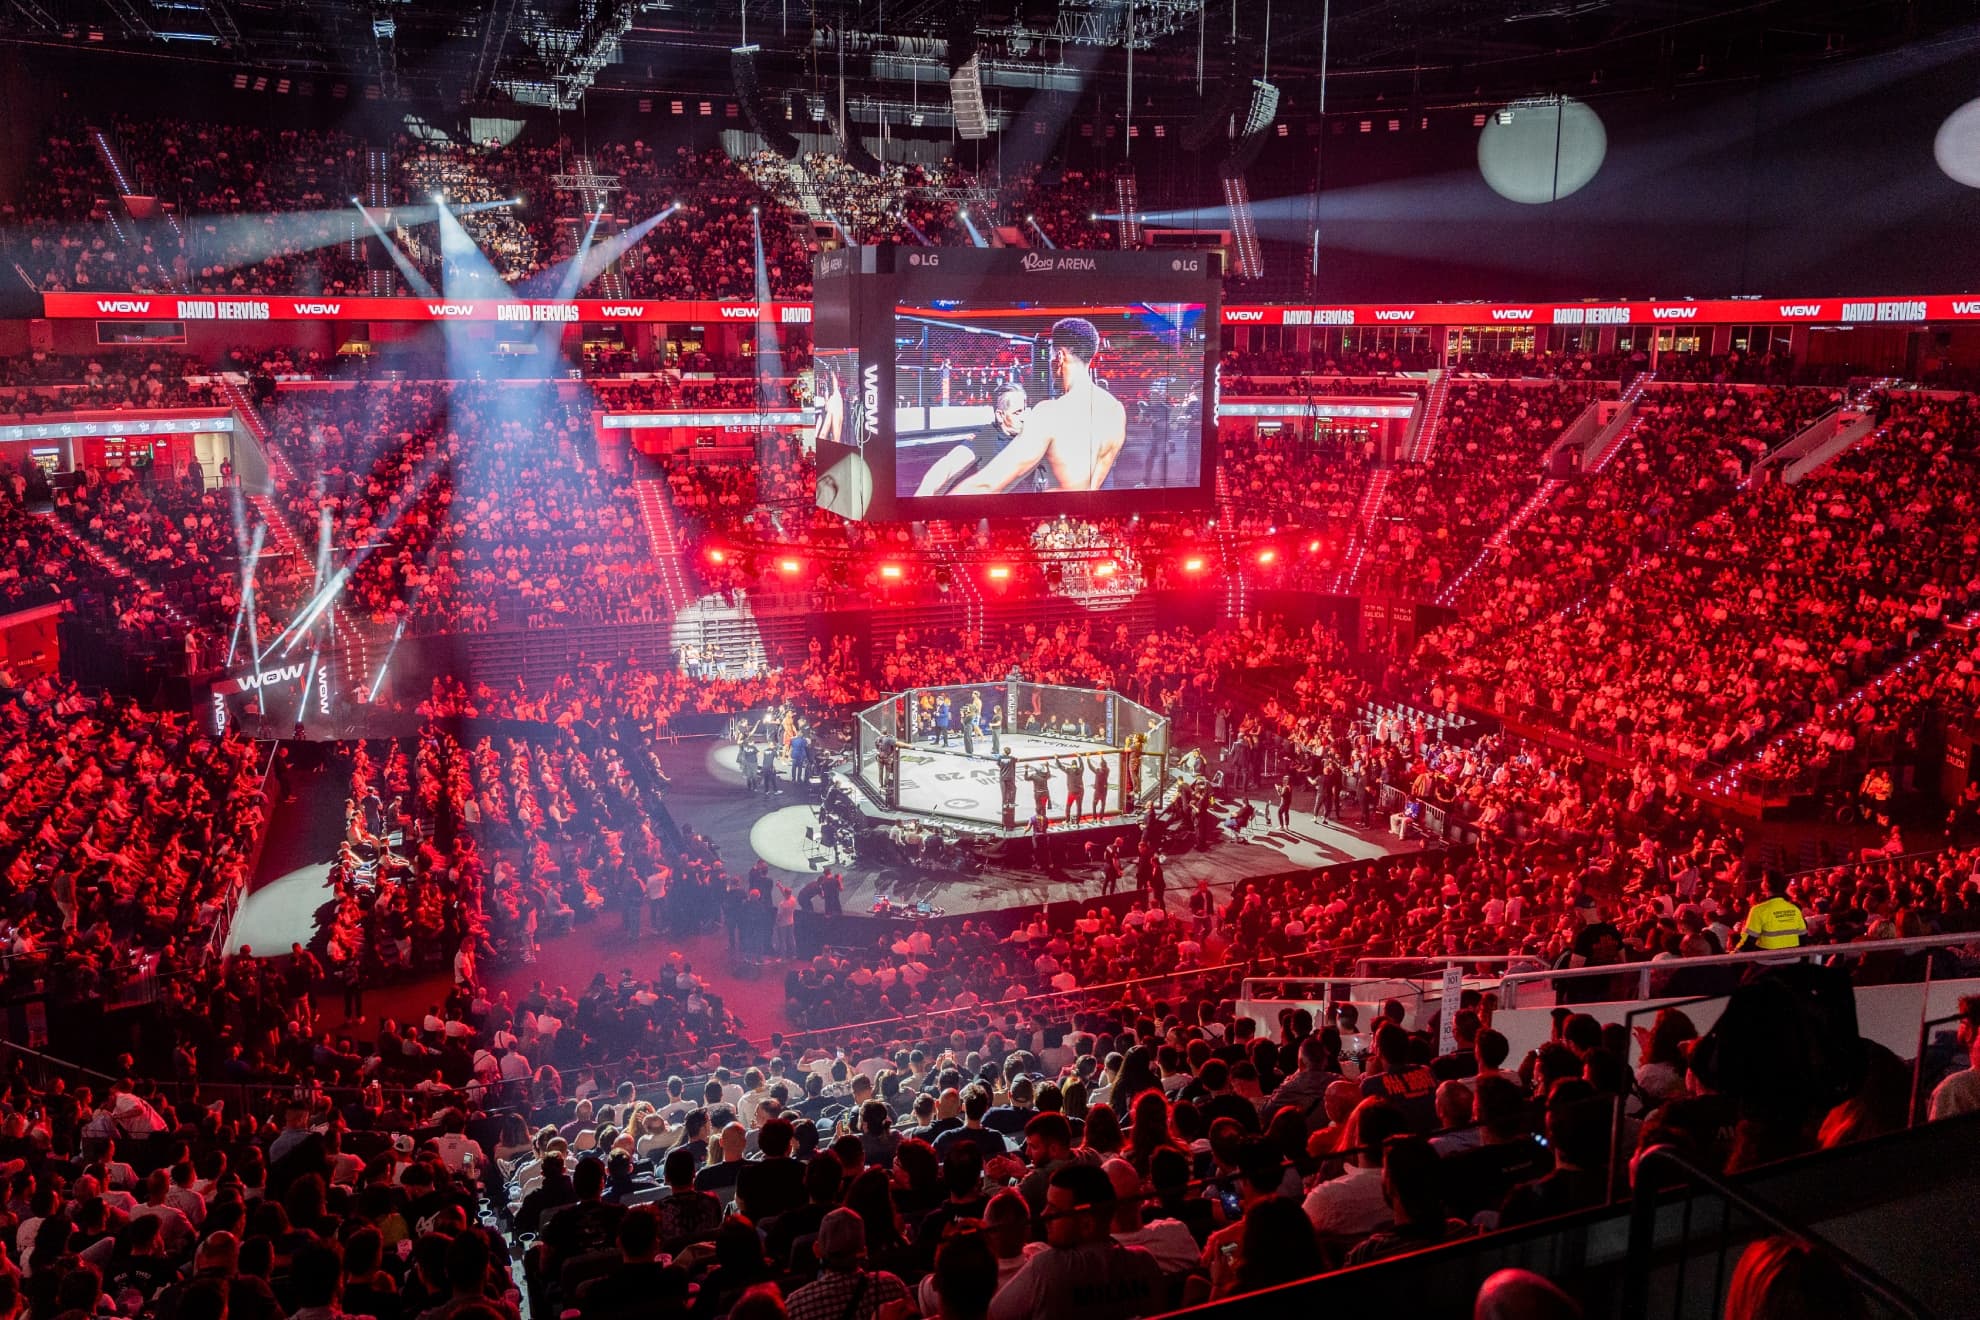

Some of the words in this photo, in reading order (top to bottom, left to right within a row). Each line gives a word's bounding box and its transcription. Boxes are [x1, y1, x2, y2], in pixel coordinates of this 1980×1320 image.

[921, 254, 939, 266] LG
[1020, 252, 1054, 272] Roig
[1057, 258, 1097, 271] ARENA
[1183, 259, 1198, 272] LG
[96, 301, 150, 313] WOW
[177, 301, 215, 319] DAVID
[217, 300, 270, 320] HERVÍAS
[294, 303, 341, 315] WOW
[428, 304, 474, 316] WOW
[497, 304, 530, 321] DAVID
[532, 303, 580, 322] HERVÍAS
[601, 306, 644, 317] WOW
[720, 307, 761, 318] WOW
[1652, 307, 1698, 318] WOW
[1780, 305, 1822, 317] WOW
[1841, 303, 1876, 322] DAVID
[1877, 300, 1928, 321] HERVÍAS
[781, 307, 812, 323] DAVID
[1225, 311, 1264, 321] WOW
[1282, 310, 1312, 325] DAVID
[1313, 308, 1355, 325] HERVÍAS
[1375, 310, 1415, 320] WOW
[1492, 309, 1534, 320] WOW
[1553, 308, 1584, 324] DAVID
[1585, 305, 1631, 324] HERVÍAS
[864, 363, 879, 435] WOW
[237, 663, 304, 690] WOW
[318, 665, 329, 714] WOW
[1447, 976, 1458, 984] 101
